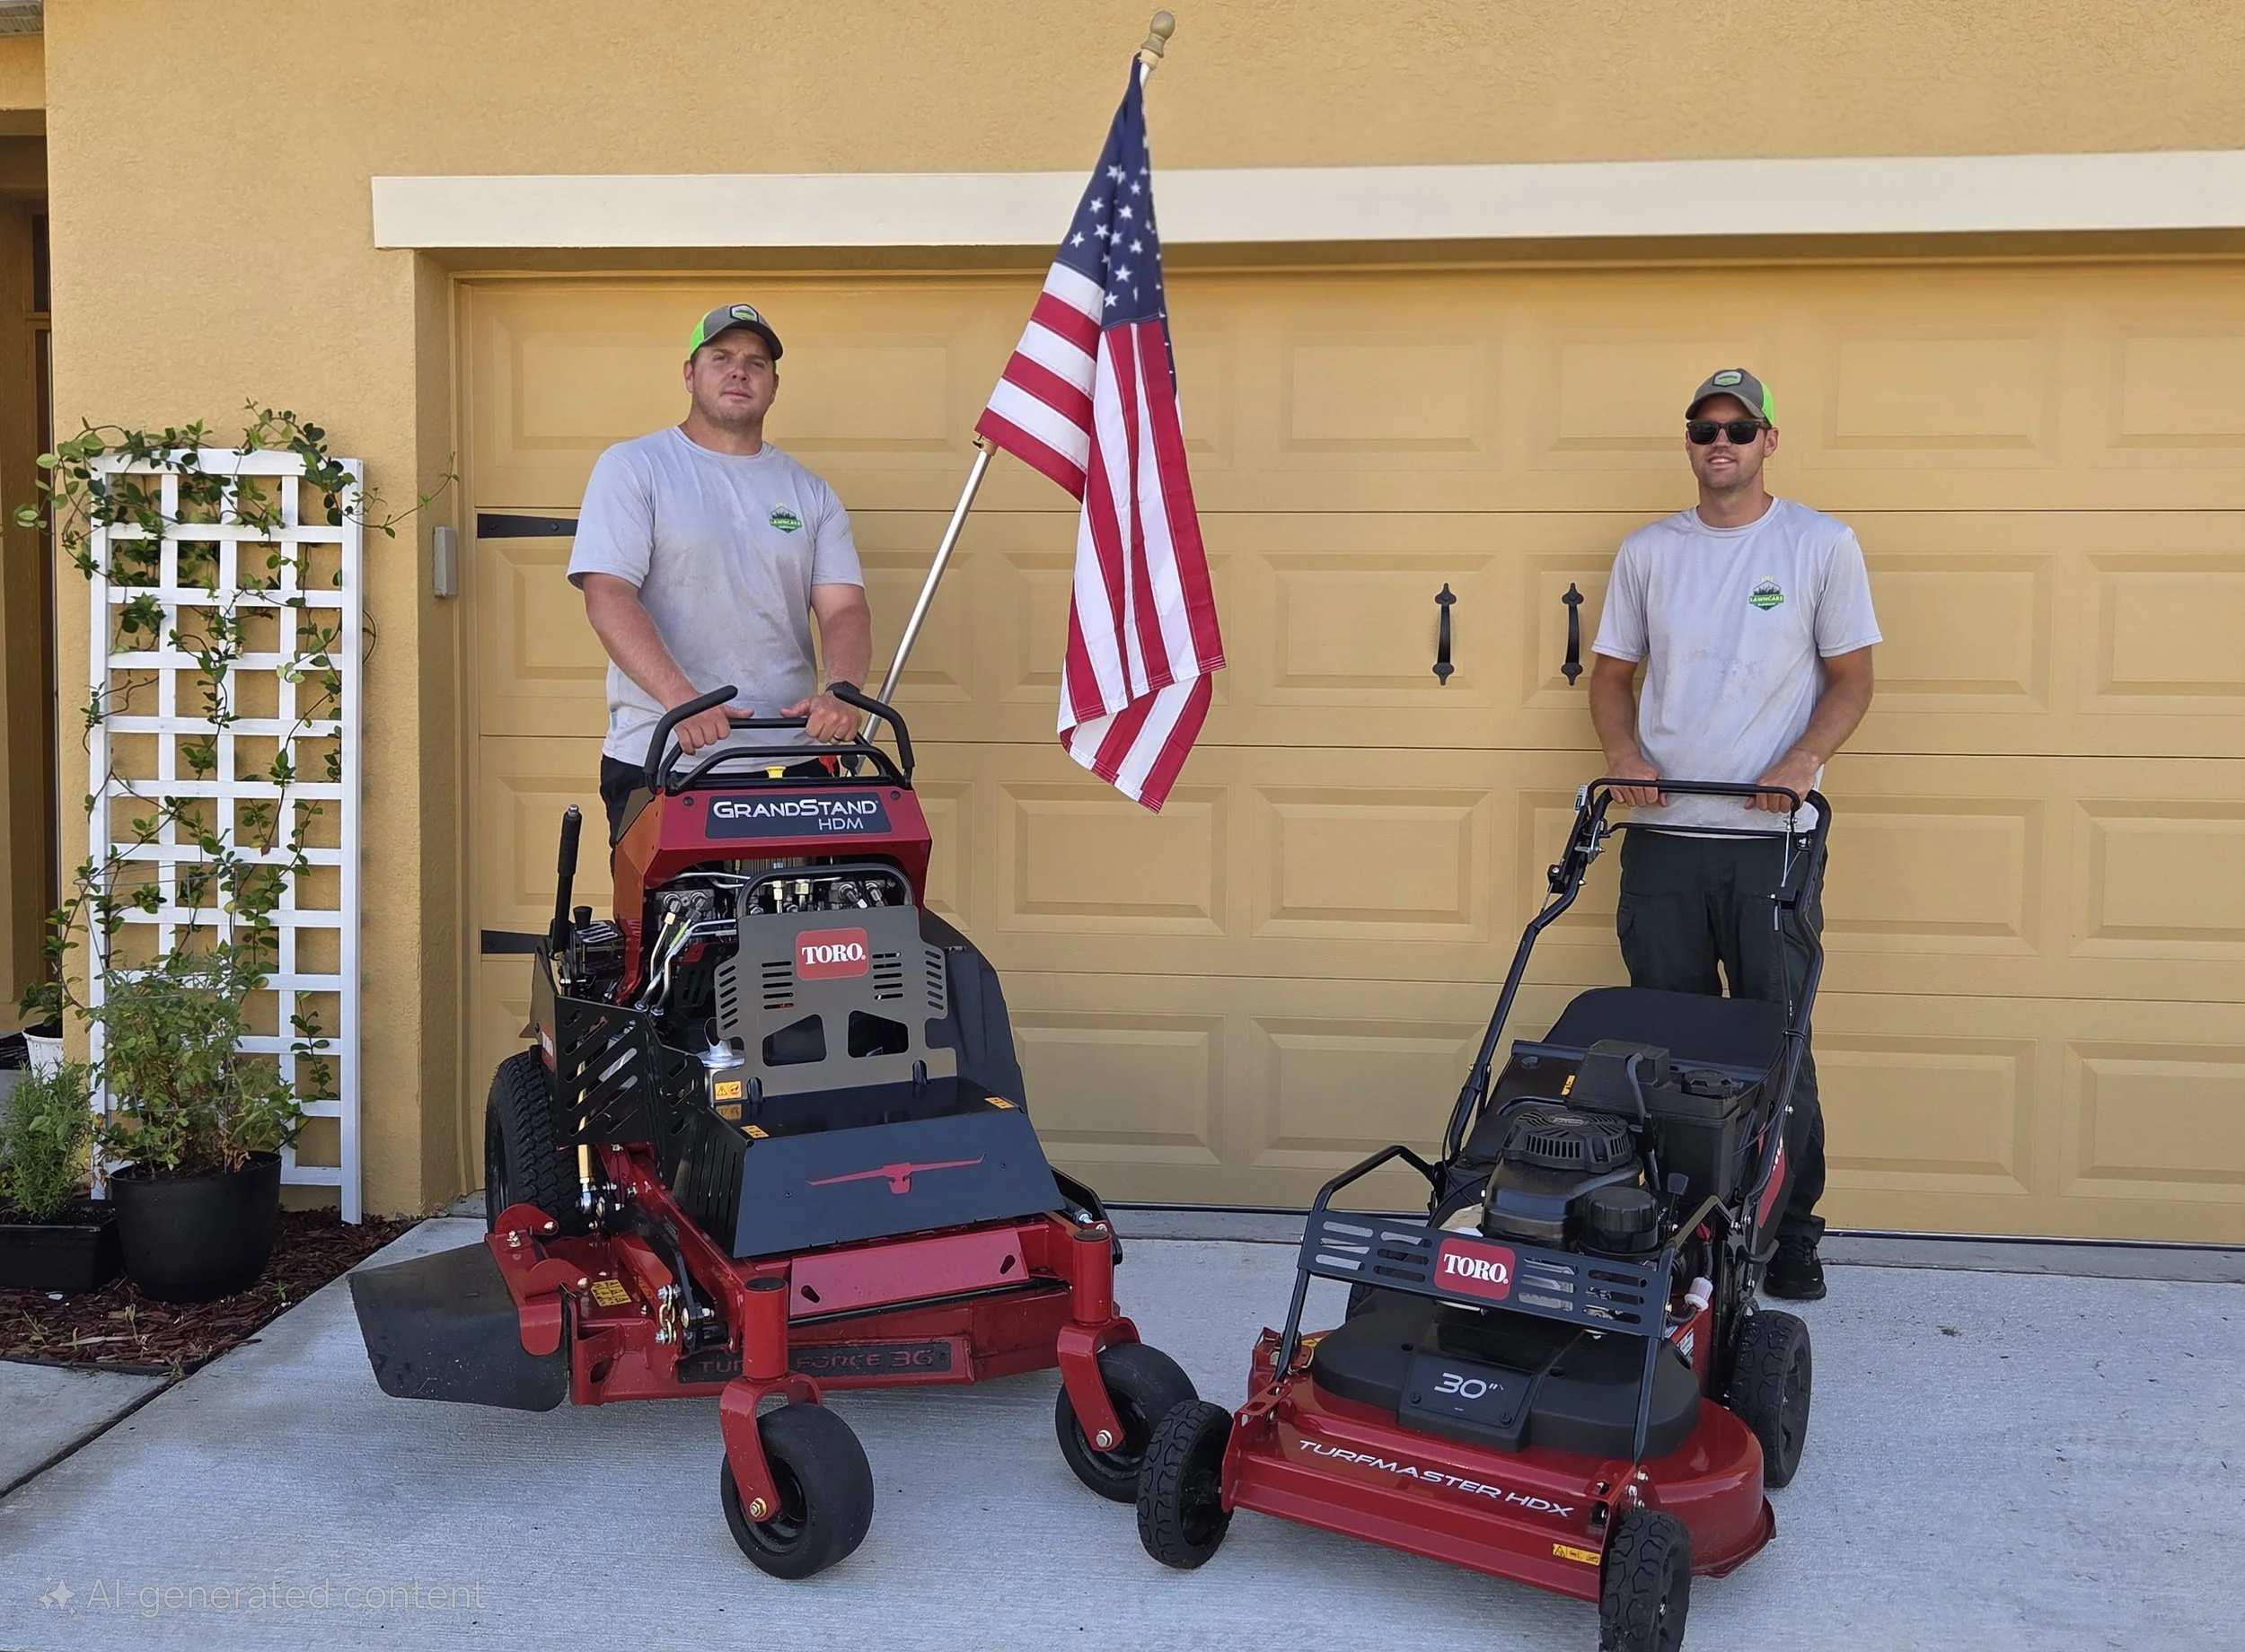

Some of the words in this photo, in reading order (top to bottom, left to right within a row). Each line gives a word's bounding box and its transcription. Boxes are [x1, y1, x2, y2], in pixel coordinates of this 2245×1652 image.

[818, 817, 863, 830] HDM
[801, 943, 863, 965] TORO
[1443, 1253, 1507, 1283] TORO
[890, 1349, 934, 1367] 36
[1299, 1440, 1501, 1498] TURFMASTER
[1505, 1492, 1574, 1517] HDX
